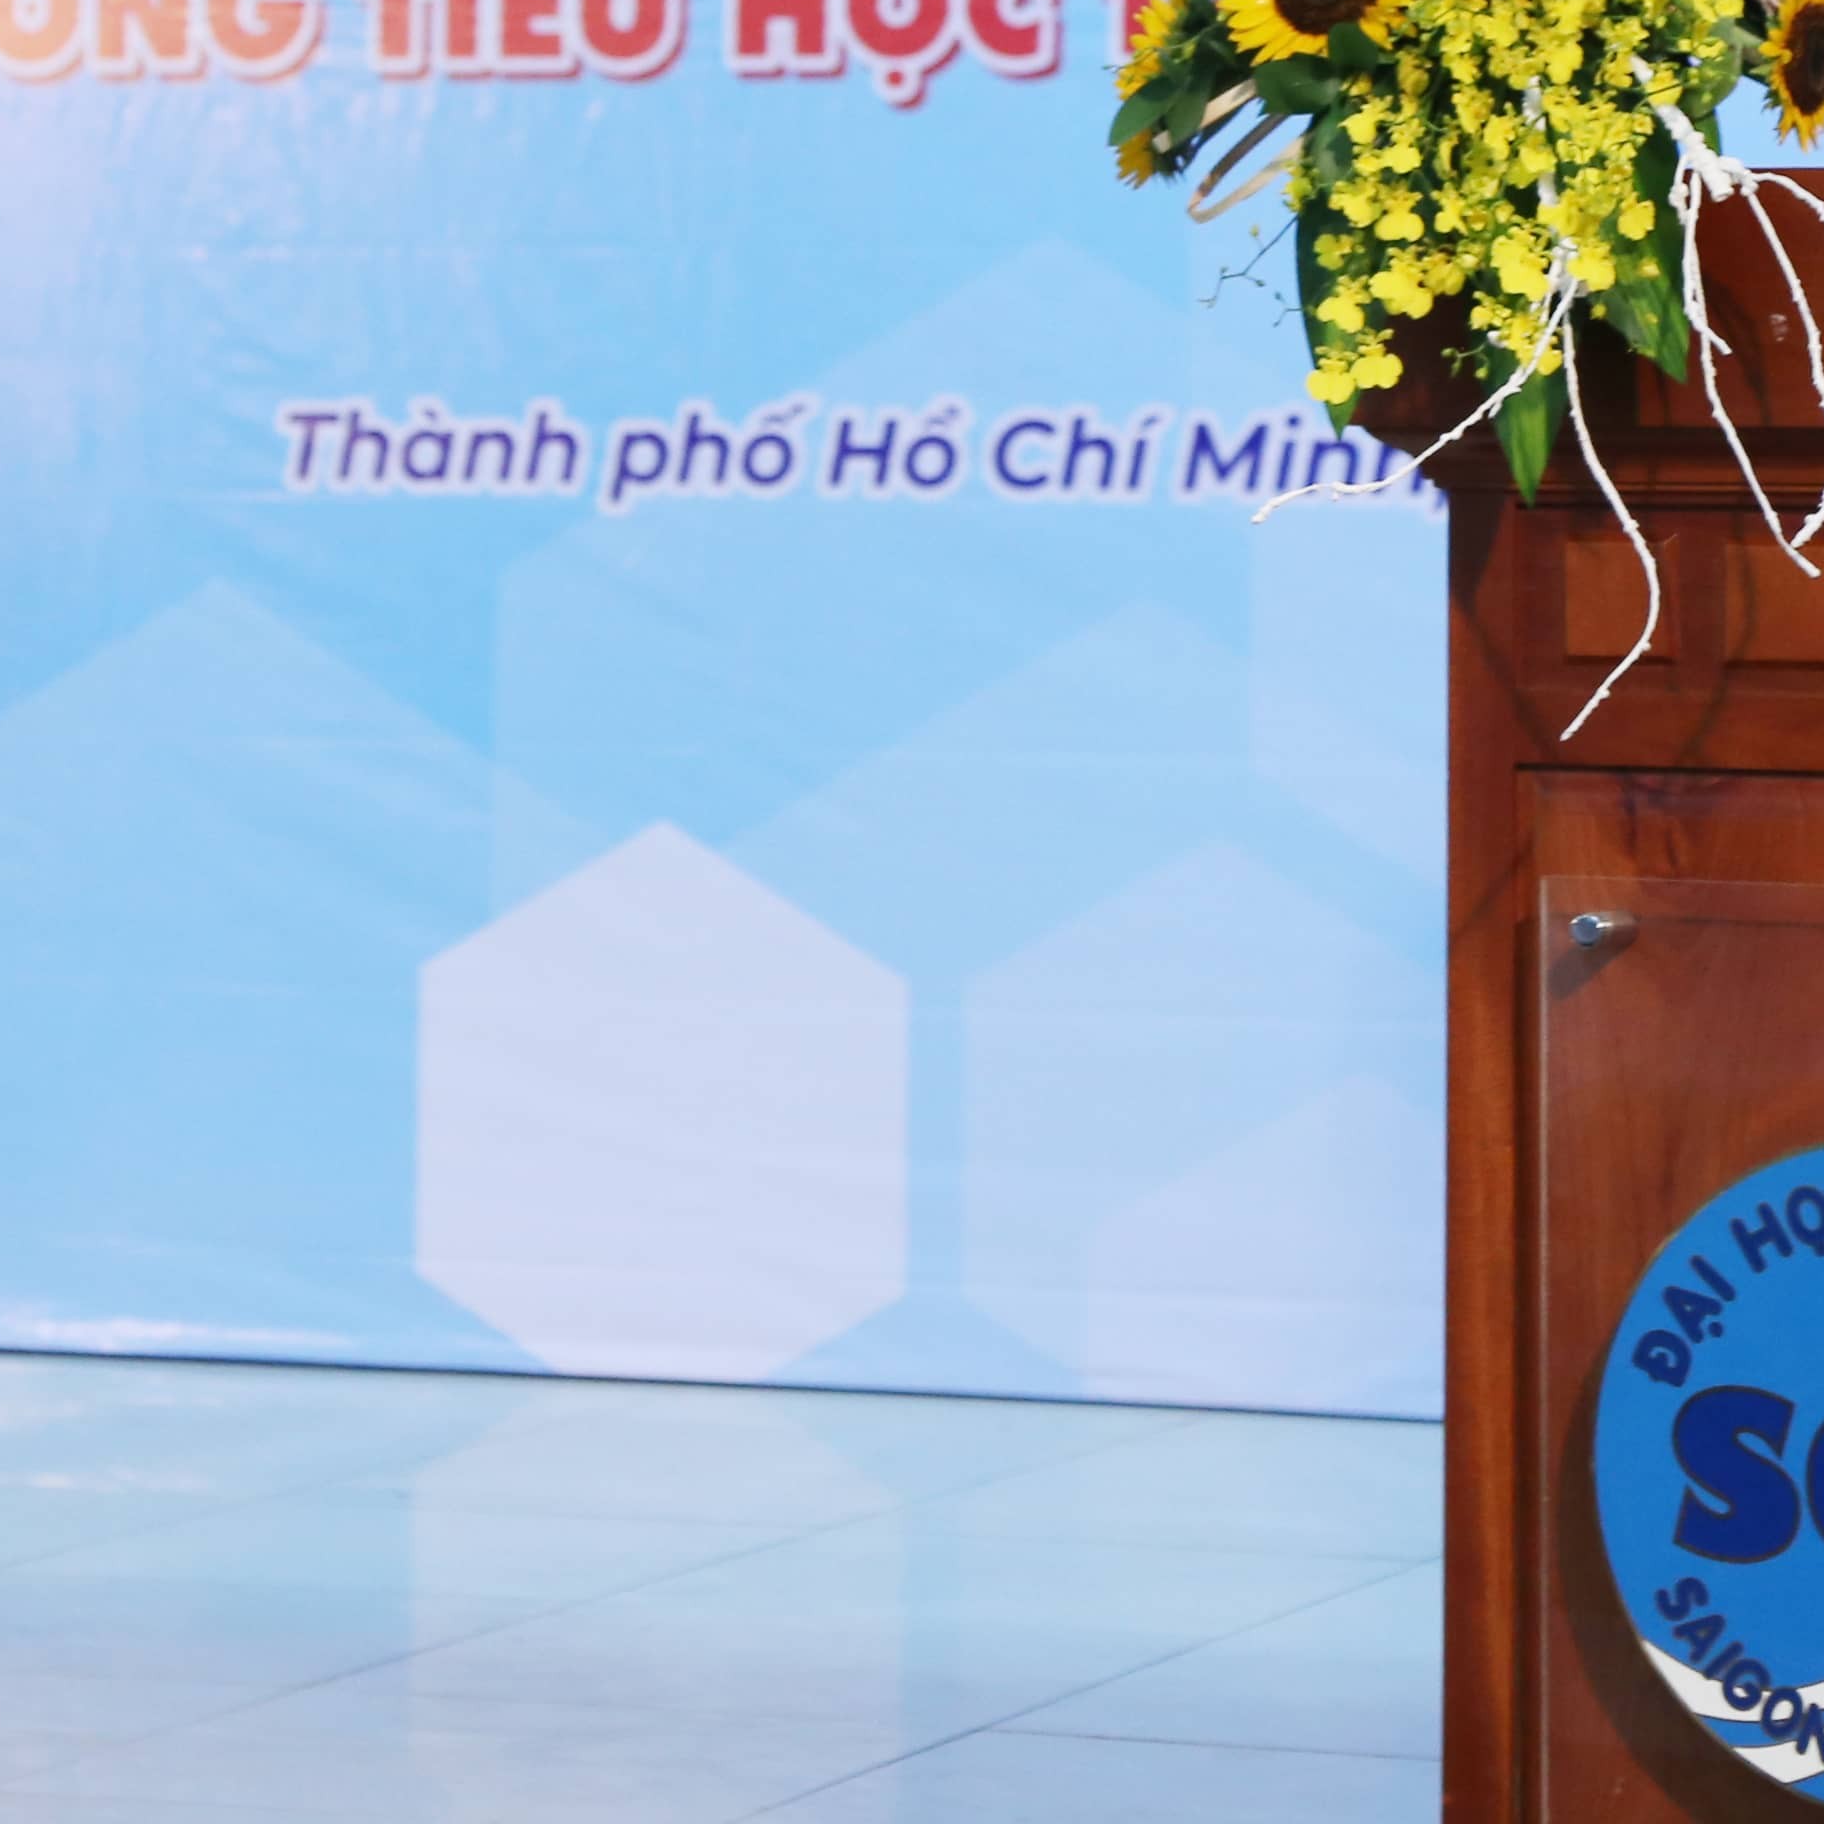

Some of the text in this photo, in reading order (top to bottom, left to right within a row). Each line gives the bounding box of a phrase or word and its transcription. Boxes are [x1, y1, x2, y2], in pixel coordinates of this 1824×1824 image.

[288, 408, 580, 484] Thành
[610, 401, 806, 505] phố
[992, 412, 1160, 490] Chí
[1631, 1255, 1737, 1389] ĐẠI
